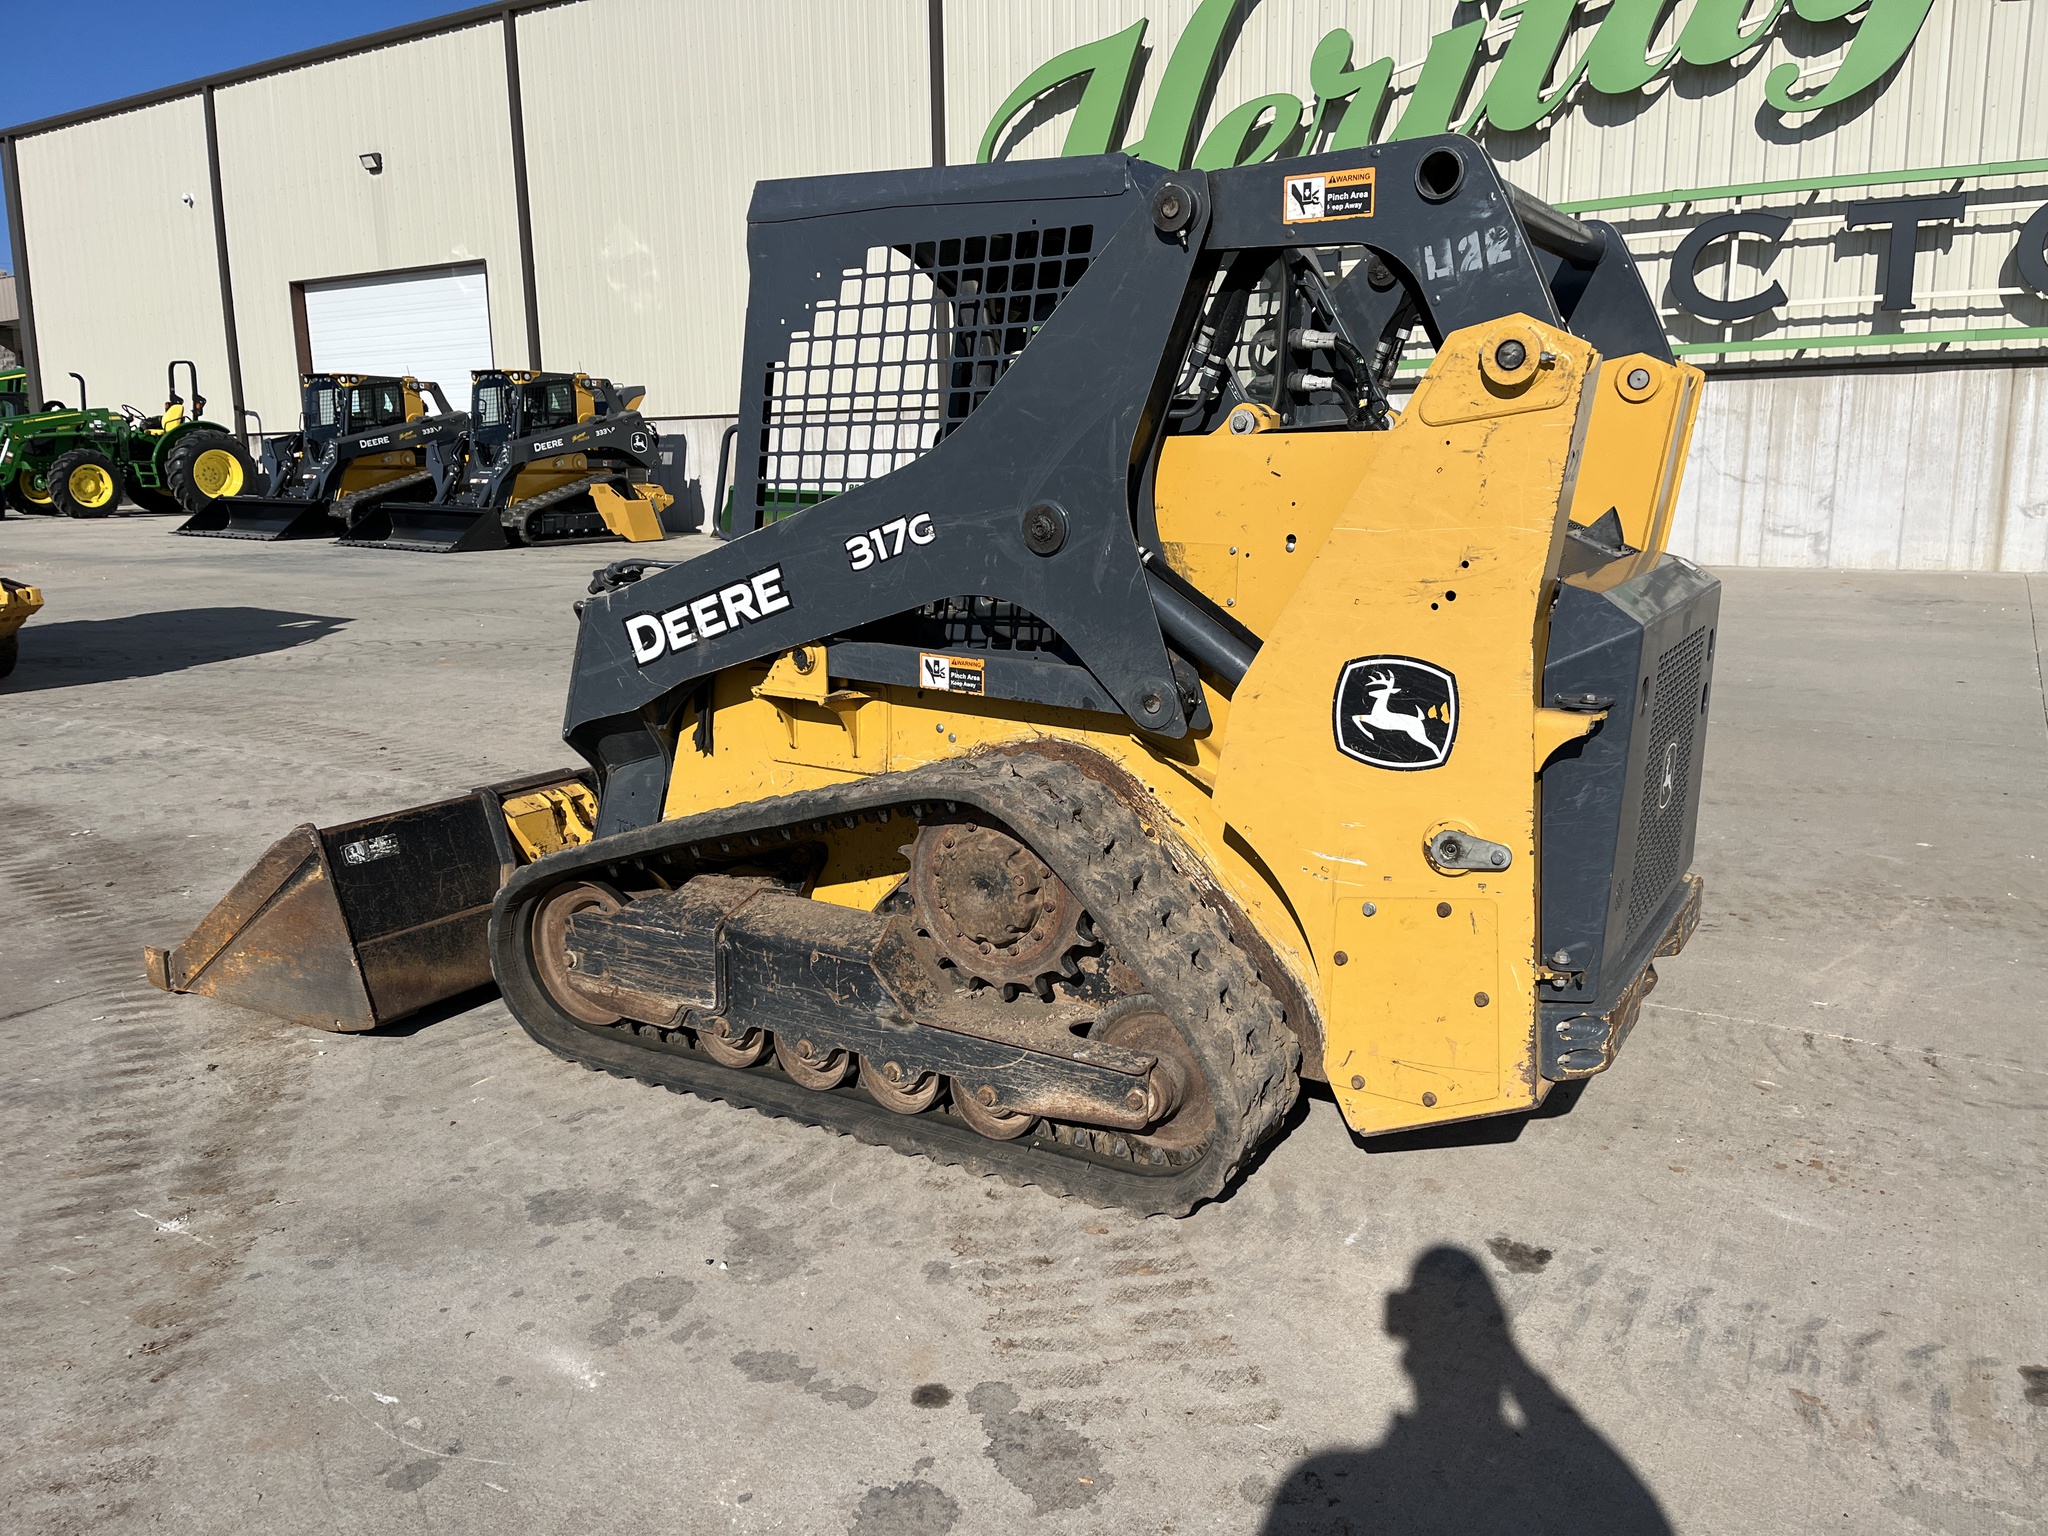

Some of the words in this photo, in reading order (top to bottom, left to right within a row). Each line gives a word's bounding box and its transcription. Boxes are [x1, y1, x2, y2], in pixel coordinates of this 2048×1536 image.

[1336, 172, 1371, 182] WARNING
[1327, 192, 1349, 201] Pinch
[1350, 190, 1369, 199] Area
[359, 436, 390, 448] DEERE
[533, 438, 564, 452] DEERE
[846, 513, 936, 570] 317G
[625, 567, 791, 665] DEERE
[956, 660, 982, 668] WARNING
